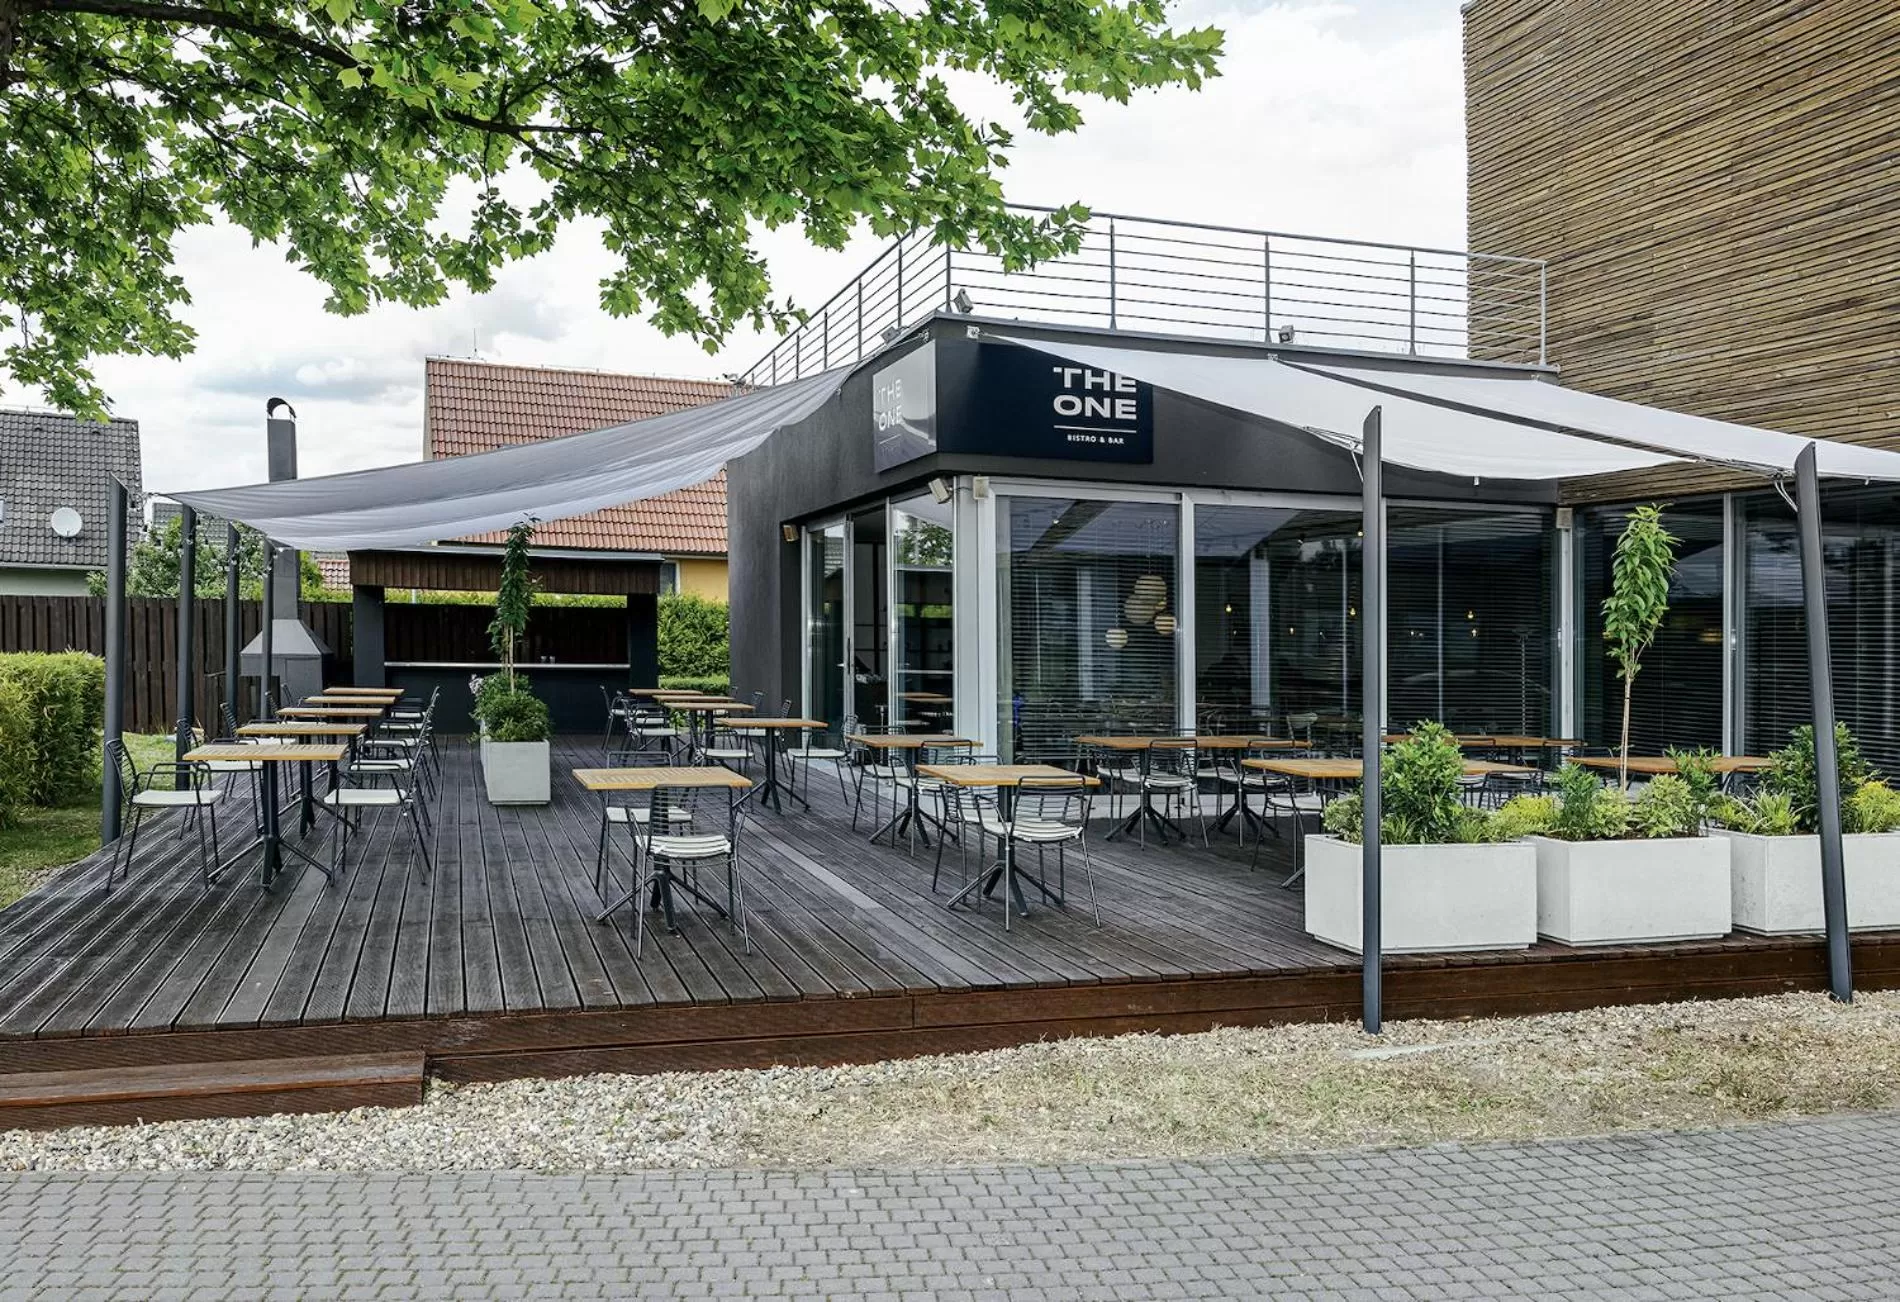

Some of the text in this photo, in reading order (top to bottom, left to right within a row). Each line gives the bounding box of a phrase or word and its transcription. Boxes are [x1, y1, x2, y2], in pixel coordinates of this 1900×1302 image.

[879, 379, 901, 402] THE
[1053, 367, 1137, 393] THE
[879, 405, 902, 431] ONE
[1053, 394, 1137, 420] ONE
[1067, 434, 1097, 443] BISTRO
[1107, 436, 1125, 444] BAR
